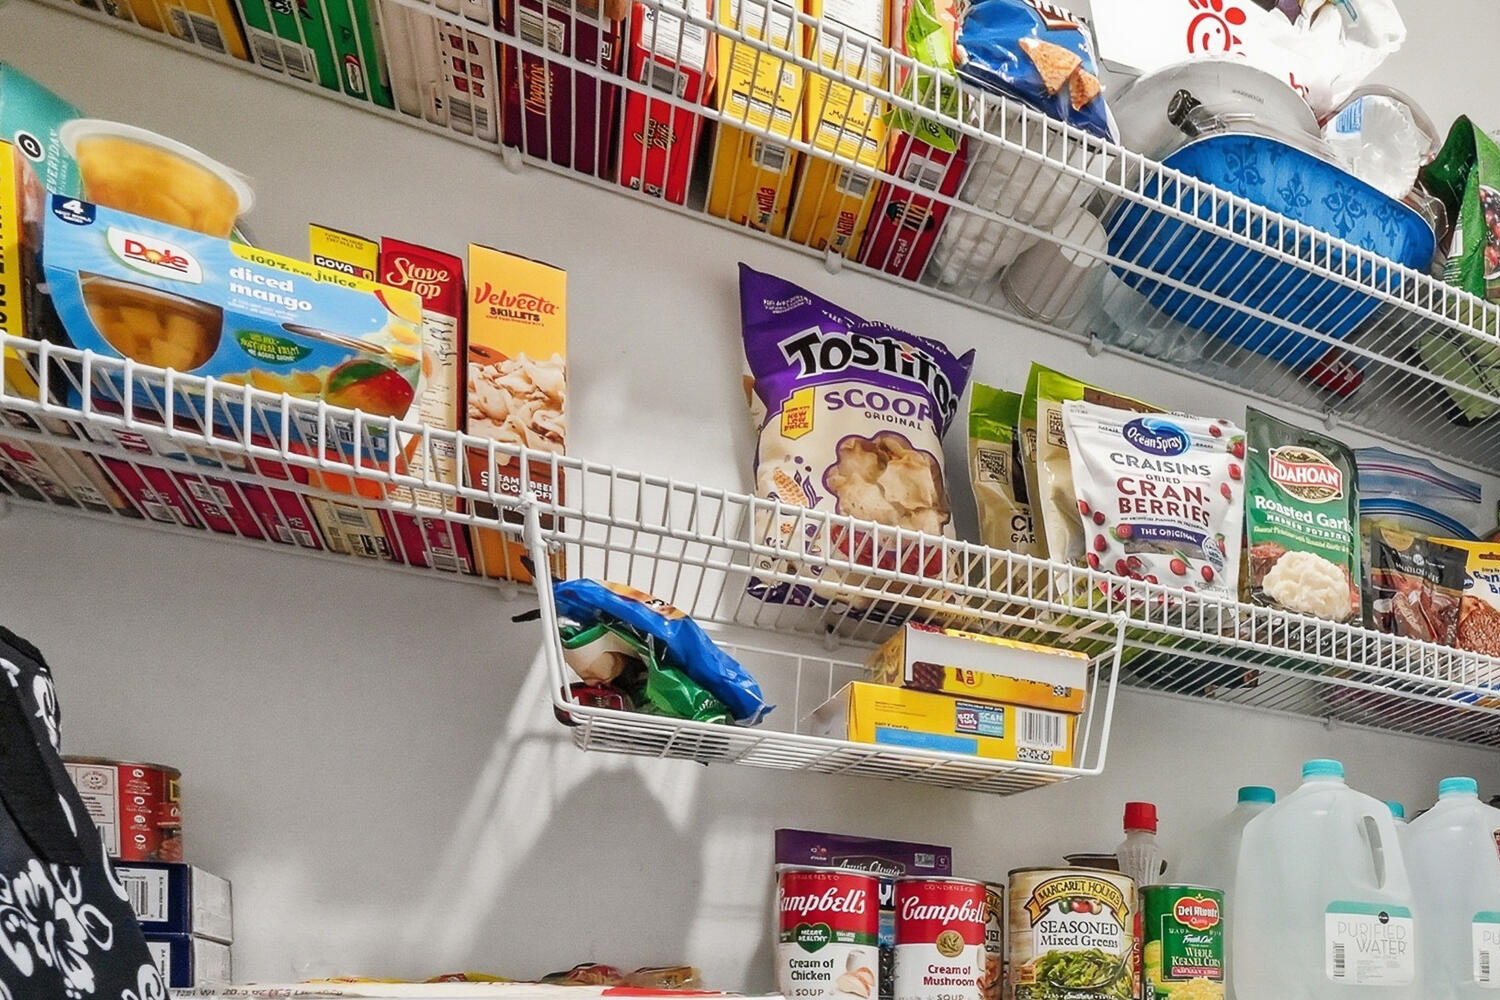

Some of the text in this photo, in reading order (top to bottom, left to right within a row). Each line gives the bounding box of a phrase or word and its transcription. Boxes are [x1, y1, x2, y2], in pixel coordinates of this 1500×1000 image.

[63, 199, 84, 214] 4
[124, 239, 189, 268] Dole
[315, 257, 354, 274] GOYA
[386, 257, 449, 286] Stove
[229, 267, 294, 292] diced
[315, 271, 357, 288] juice
[230, 282, 312, 311] mango
[408, 280, 441, 299] Top
[474, 281, 556, 315] Velveeta
[489, 307, 540, 322] SKILLETS
[1127, 428, 1182, 452] Ocean Spray
[1110, 453, 1211, 476] CRAISINS
[1273, 462, 1339, 486] IDAHOAN
[1117, 477, 1211, 505] CRAN-
[1119, 498, 1210, 527] BERRIES
[1255, 495, 1313, 524] Roasted
[1141, 528, 1156, 536] THE
[1178, 906, 1193, 916] Del
[1040, 920, 1119, 936] SEASONED
[1337, 921, 1407, 940] PURIFIED
[1040, 935, 1119, 949] Mixed Greens
[1356, 938, 1406, 954] WATER
[789, 959, 834, 968] Cream of
[928, 964, 971, 975] Cream of
[791, 970, 831, 981] Chicken
[923, 976, 975, 987] Mushroom
[796, 988, 824, 997] SOUP
